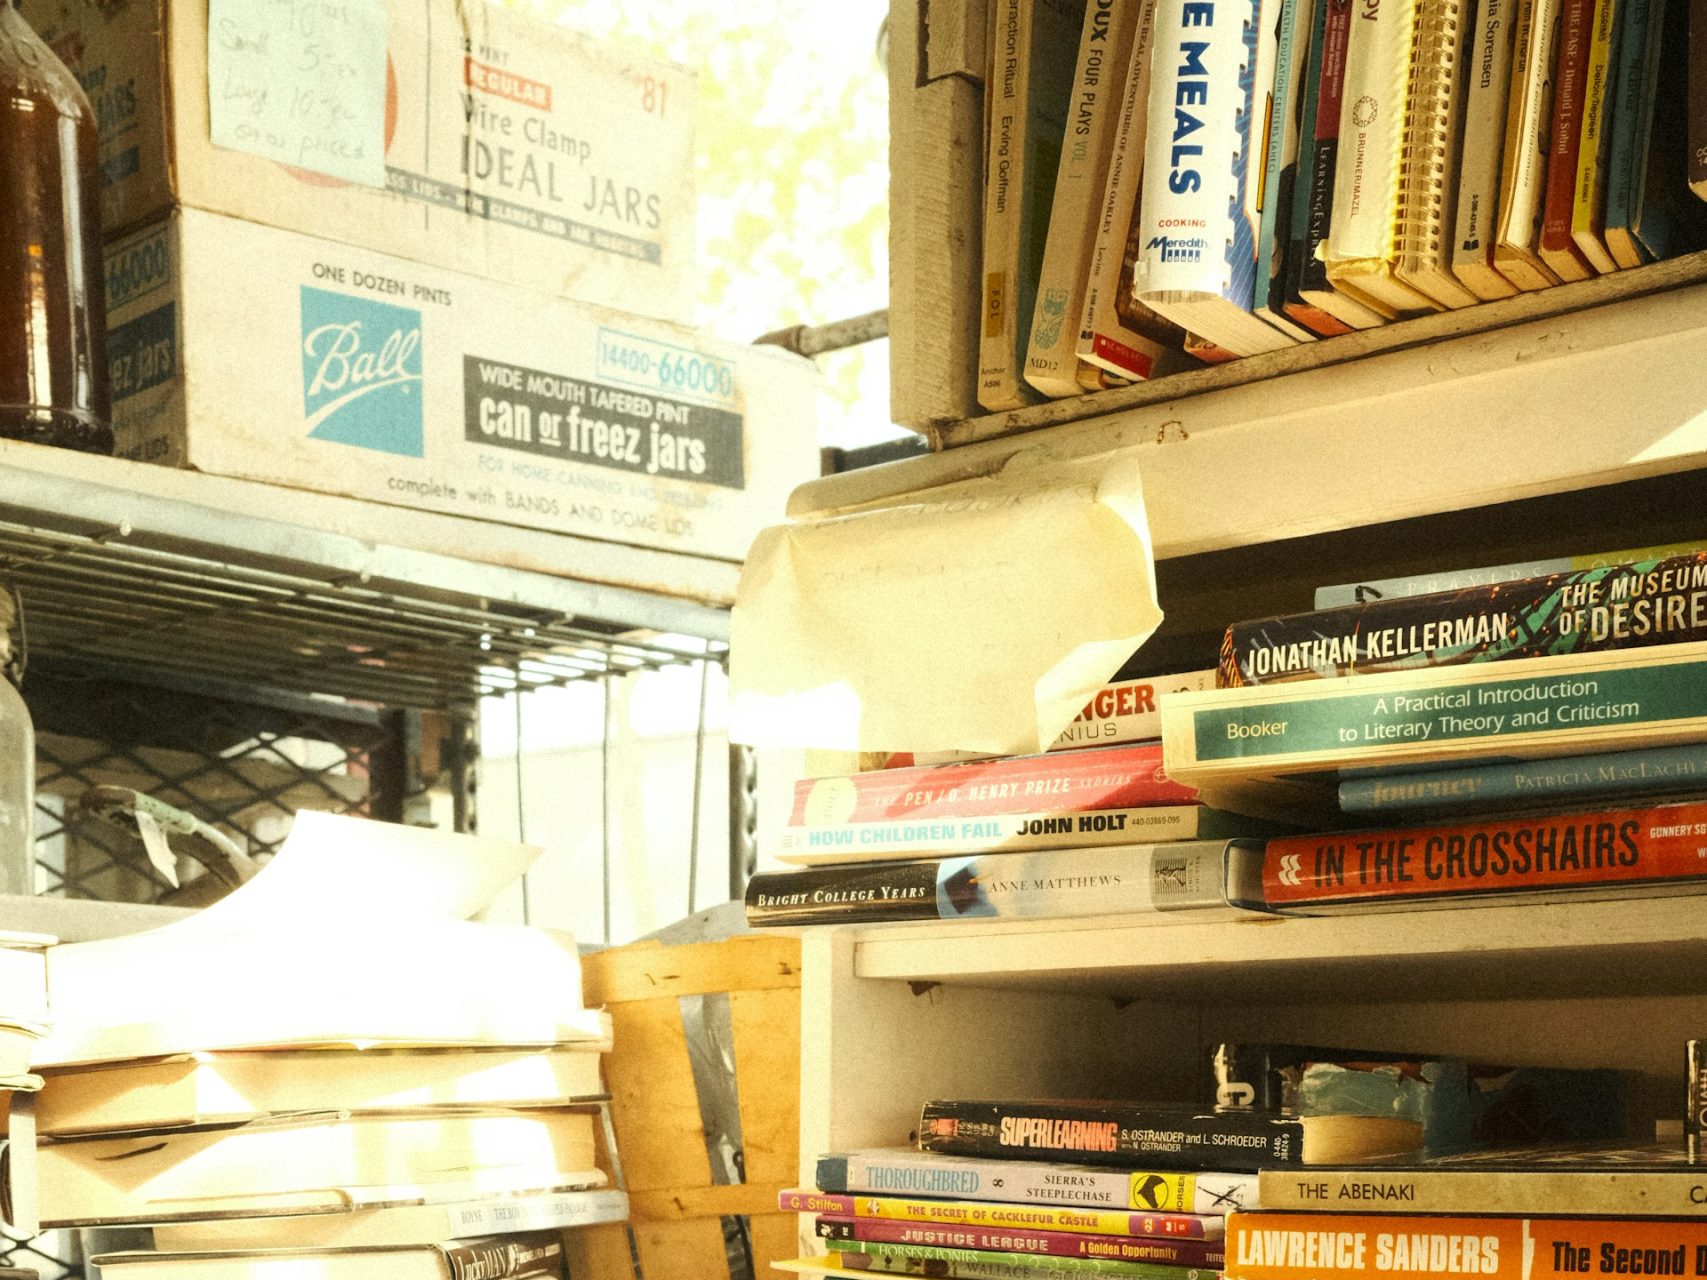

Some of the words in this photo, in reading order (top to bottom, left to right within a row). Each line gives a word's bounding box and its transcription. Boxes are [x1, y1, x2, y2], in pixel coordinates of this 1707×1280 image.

[1138, 29, 1149, 58] REAL
[1480, 21, 1500, 88] Sorensen
[1003, 58, 1017, 99] Ritual
[1084, 49, 1103, 86] FOUR
[1276, 38, 1288, 93] EDUCATION
[1075, 92, 1096, 136] PLAYS
[1122, 61, 1142, 136] ADVENTURES
[1168, 41, 1212, 195] MEALS
[524, 115, 591, 165] Clamp
[998, 115, 1012, 156] Erving
[461, 135, 563, 202] IDEAL
[584, 175, 661, 229] JARS
[1112, 154, 1126, 189] ANNIE
[1351, 132, 1366, 218] BRUNNER/MAZEL
[1103, 190, 1117, 234] OAKLEY
[1158, 218, 1207, 229] COOKING
[1145, 235, 1208, 263] Meredith
[313, 262, 346, 283] ONE
[353, 271, 405, 296] DOZEN
[413, 285, 451, 306] PINTS
[136, 338, 170, 389] jars
[303, 320, 421, 397] Ball
[602, 343, 733, 398] 14400-66000
[1029, 357, 1058, 371] MD12
[479, 363, 523, 390] WIDE
[527, 374, 586, 406] MOUTH
[589, 386, 654, 419] TAPERED
[655, 401, 691, 425] PINT
[479, 397, 532, 443] can
[538, 411, 562, 440] or
[566, 405, 641, 465] freez
[646, 422, 706, 474] jars
[1561, 581, 1601, 608] THE
[1611, 564, 1707, 601] MUSEUM
[1559, 610, 1586, 636] OF
[1591, 591, 1707, 642] DESIRE
[1247, 634, 1358, 677] JONATHAN
[1366, 612, 1508, 660] KELLERMAN
[1373, 699, 1388, 715] A
[1395, 690, 1471, 713] Practical
[1478, 680, 1598, 707] Introduction
[1227, 719, 1288, 740] Booker
[1339, 726, 1358, 742] to
[1364, 721, 1432, 741] Literary
[1438, 714, 1504, 735] Theory
[1511, 708, 1549, 728] and
[1557, 701, 1640, 723] Criticism
[970, 782, 1019, 801] HENRY
[1025, 777, 1071, 797] PRIZE
[808, 830, 854, 847] HOW
[860, 825, 955, 845] CHILDREN
[961, 821, 1003, 840] FAIL
[1016, 816, 1073, 836] JOHN
[1078, 814, 1128, 833] HOLT
[1650, 824, 1692, 839] GUNNERY
[1315, 845, 1345, 888] IN
[1356, 839, 1415, 885] THE
[1424, 820, 1640, 881] CROSSHAIRS
[988, 879, 1030, 893] ANNE
[1033, 875, 1122, 891] MATTHEWS
[999, 1116, 1118, 1153] SUPERLEARNING
[1131, 1130, 1184, 1144] OSTRANDER
[1185, 1131, 1201, 1144] and
[1212, 1134, 1267, 1148] SCHROEDER
[1141, 1142, 1182, 1152] OSTRANDER
[866, 1166, 979, 1194] THOROUGHBRED
[1026, 1187, 1112, 1202] STEEPLECHASE
[1044, 1174, 1096, 1187] SIERRA'S
[1297, 1182, 1329, 1200] THE
[1338, 1182, 1416, 1201] ABENAKI
[808, 1198, 843, 1212] Stilton
[907, 1205, 926, 1216] THE
[930, 1206, 968, 1219] SECRET
[972, 1210, 987, 1221] OF
[991, 1211, 1054, 1225] CACKLEFUR
[1058, 1216, 1098, 1228] CASTLE
[900, 1229, 976, 1247] JUSTICE
[982, 1236, 1049, 1251] LEAGUE
[1088, 1241, 1120, 1256] Golden
[1122, 1243, 1177, 1261] Opportunity
[1237, 1230, 1367, 1270] LAWRENCE
[1375, 1233, 1500, 1274] SANDERS
[1552, 1240, 1591, 1273] The
[1600, 1242, 1686, 1276] Second
